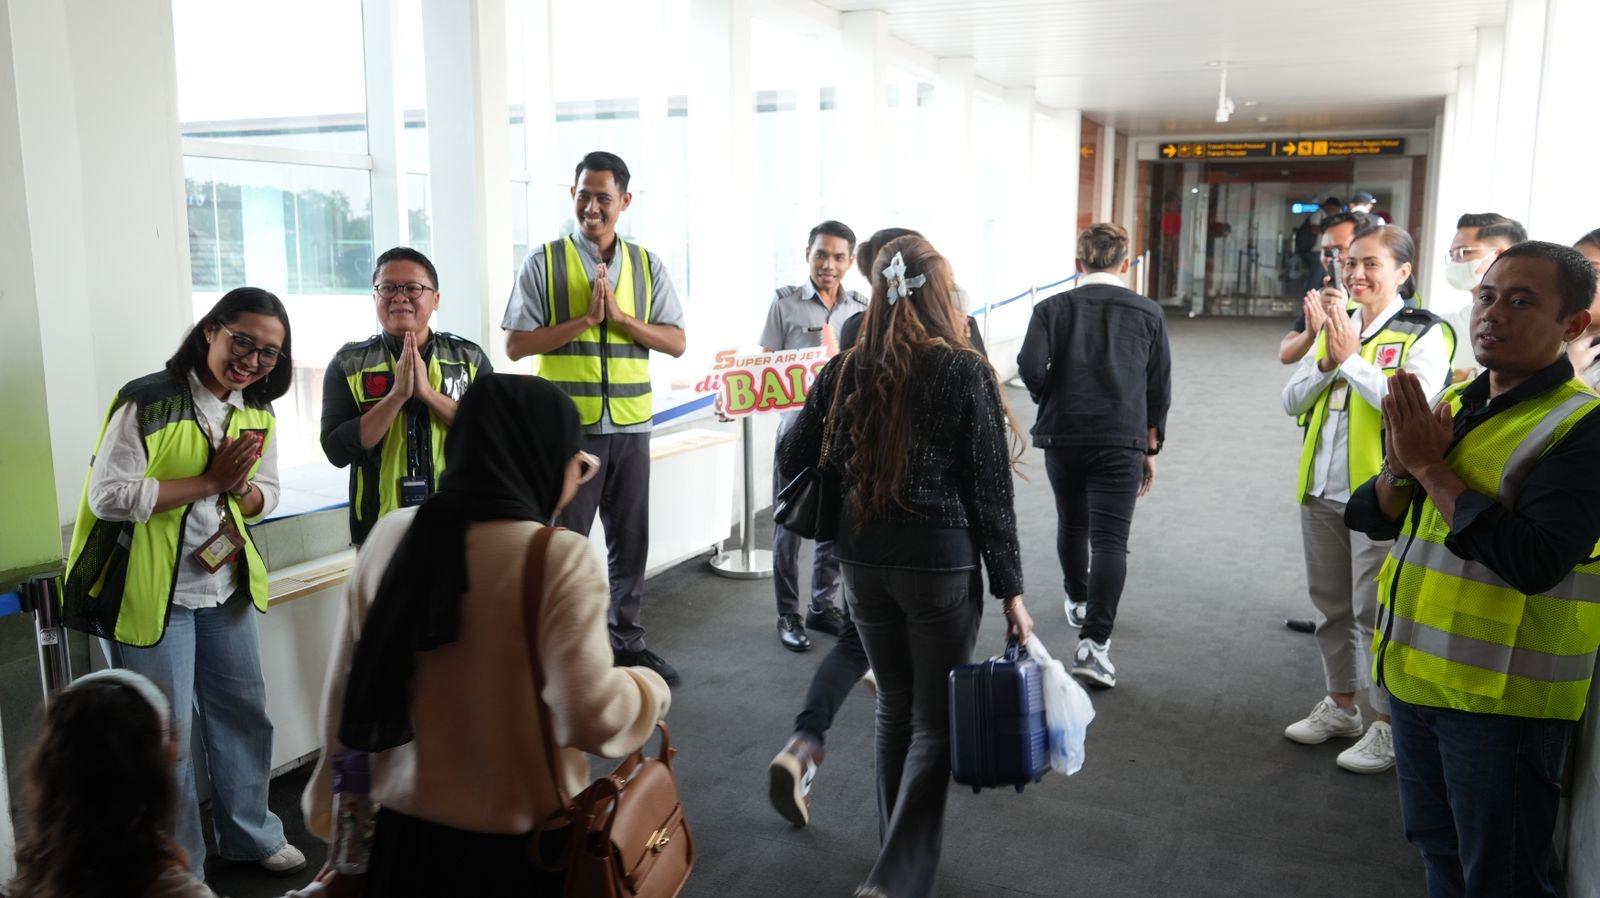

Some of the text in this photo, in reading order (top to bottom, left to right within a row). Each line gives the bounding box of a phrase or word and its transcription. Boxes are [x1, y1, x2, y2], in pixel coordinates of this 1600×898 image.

[713, 348, 822, 370] SUPER AIR JET
[694, 374, 720, 393] di
